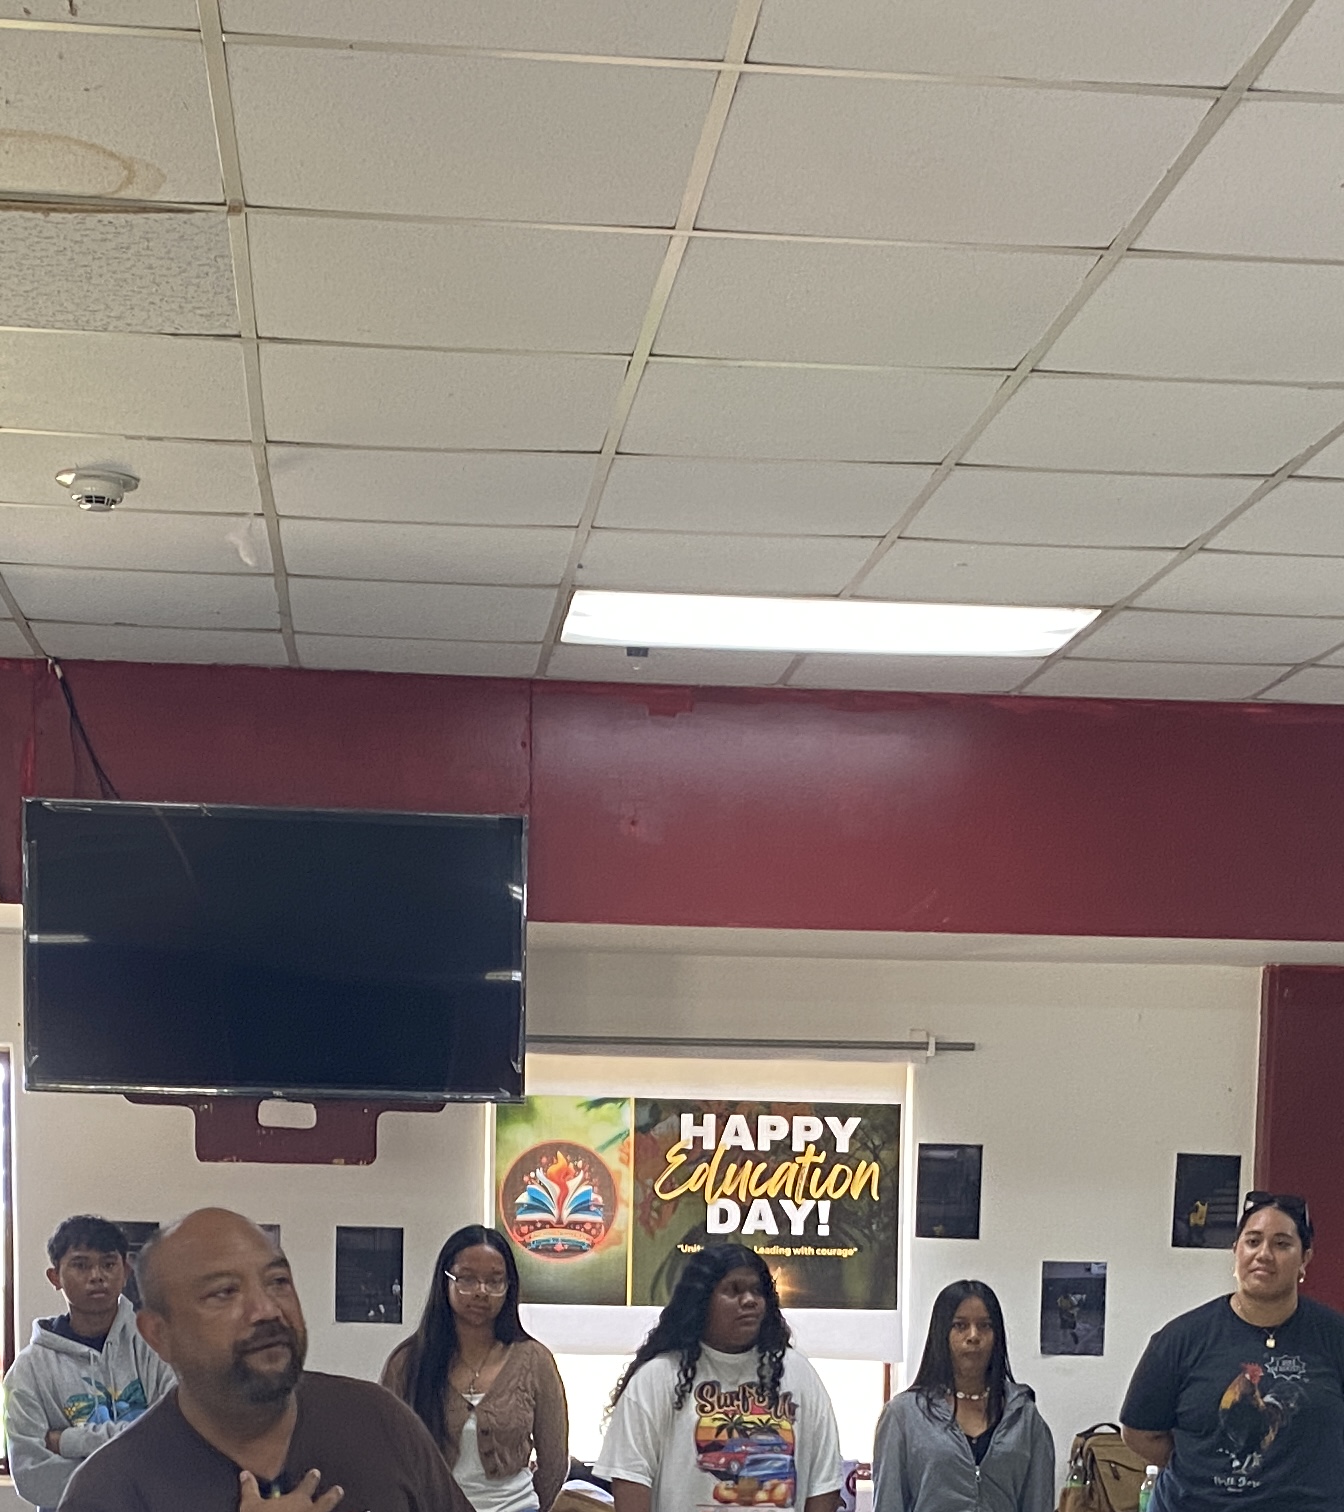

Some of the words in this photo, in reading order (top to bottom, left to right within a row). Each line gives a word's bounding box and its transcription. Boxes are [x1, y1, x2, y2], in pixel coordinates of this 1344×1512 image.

[680, 1113, 862, 1153] HAPPY
[653, 1140, 880, 1205] Education
[706, 1198, 832, 1237] DAY!
[753, 1245, 792, 1257] Leading
[792, 1246, 815, 1256] with
